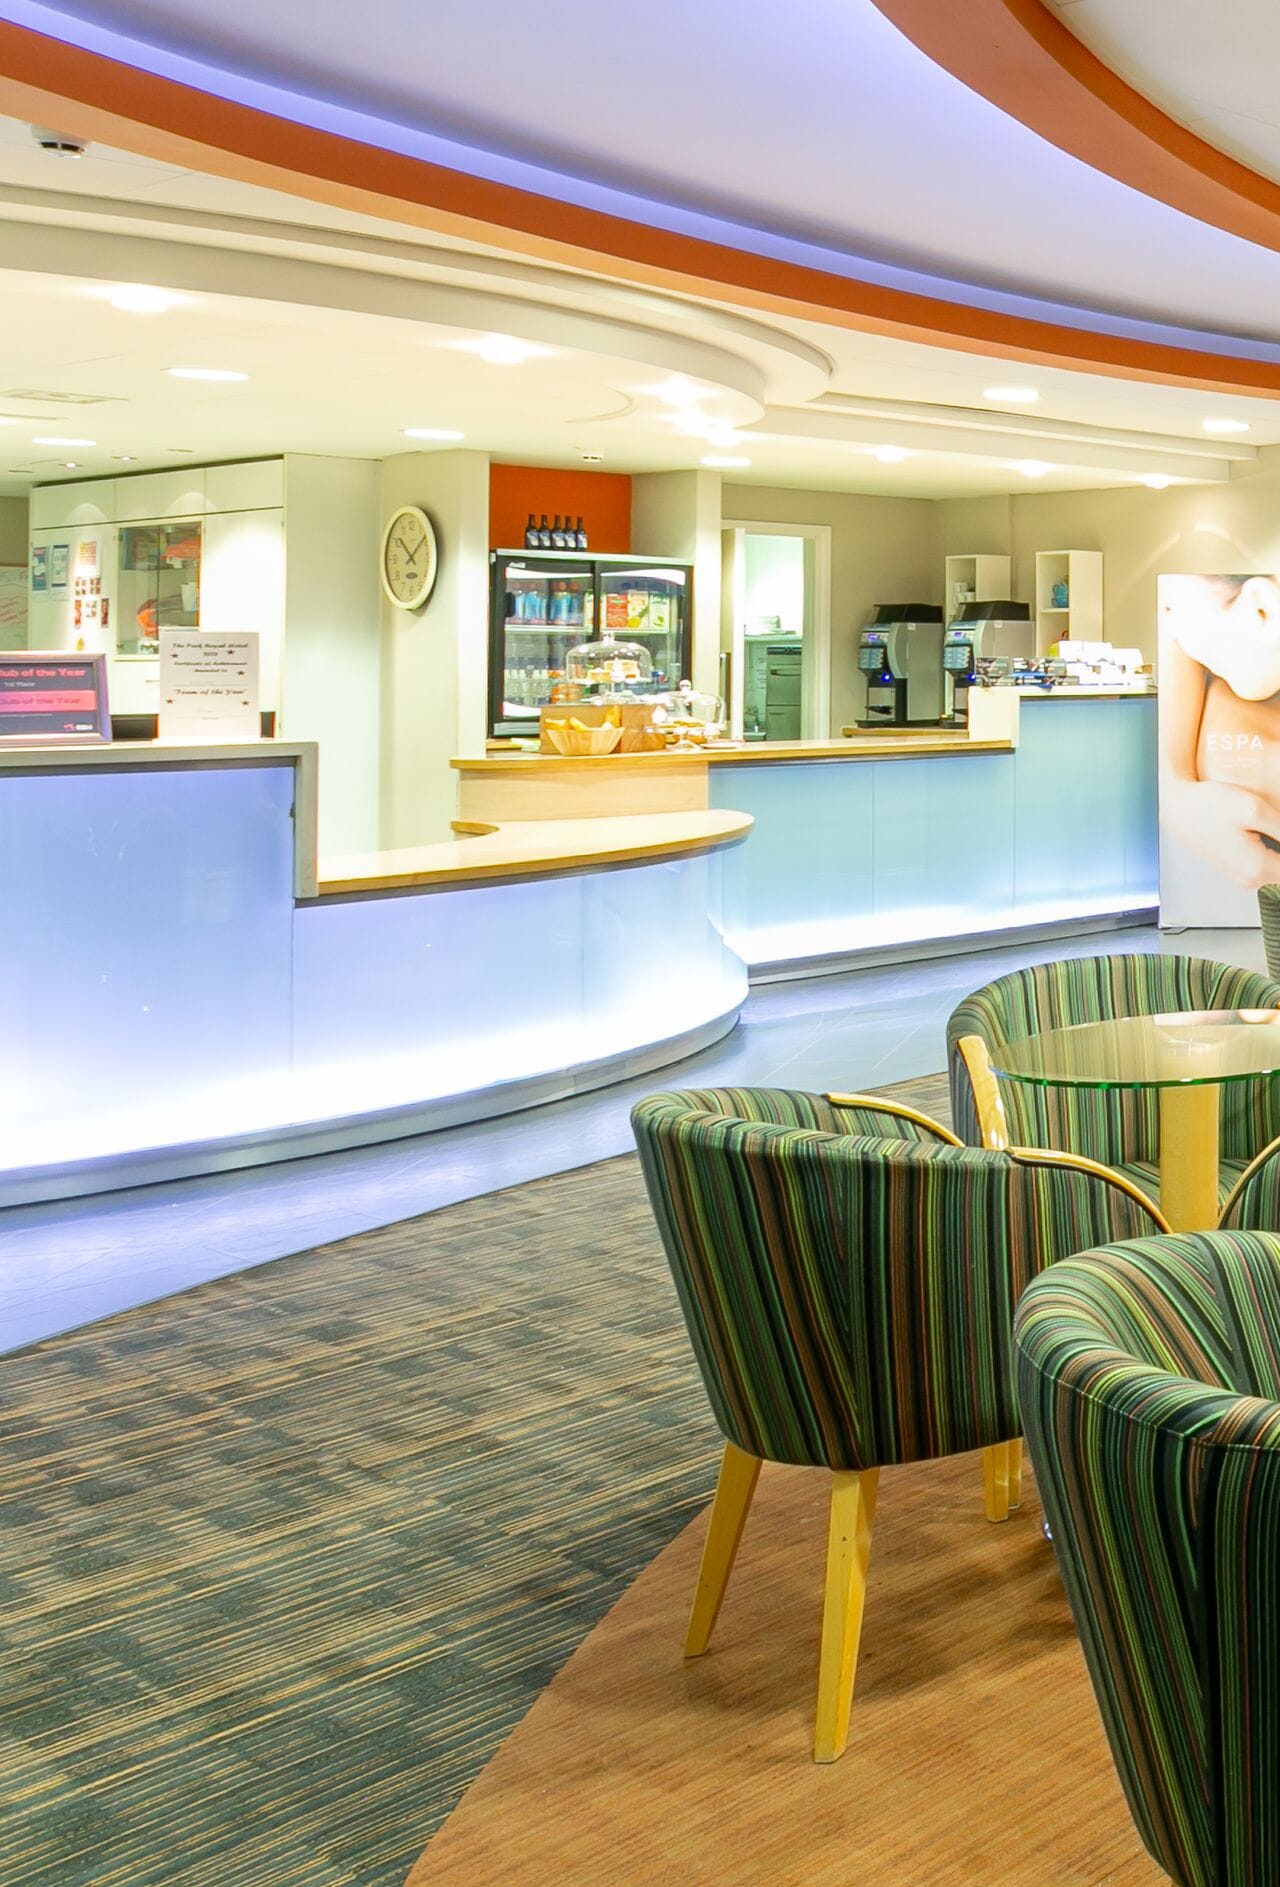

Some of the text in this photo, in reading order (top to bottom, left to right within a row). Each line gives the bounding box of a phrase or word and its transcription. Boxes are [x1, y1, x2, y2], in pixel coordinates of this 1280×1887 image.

[20, 668, 34, 677] of
[58, 667, 86, 676] Year
[1207, 733, 1264, 752] ESPA
